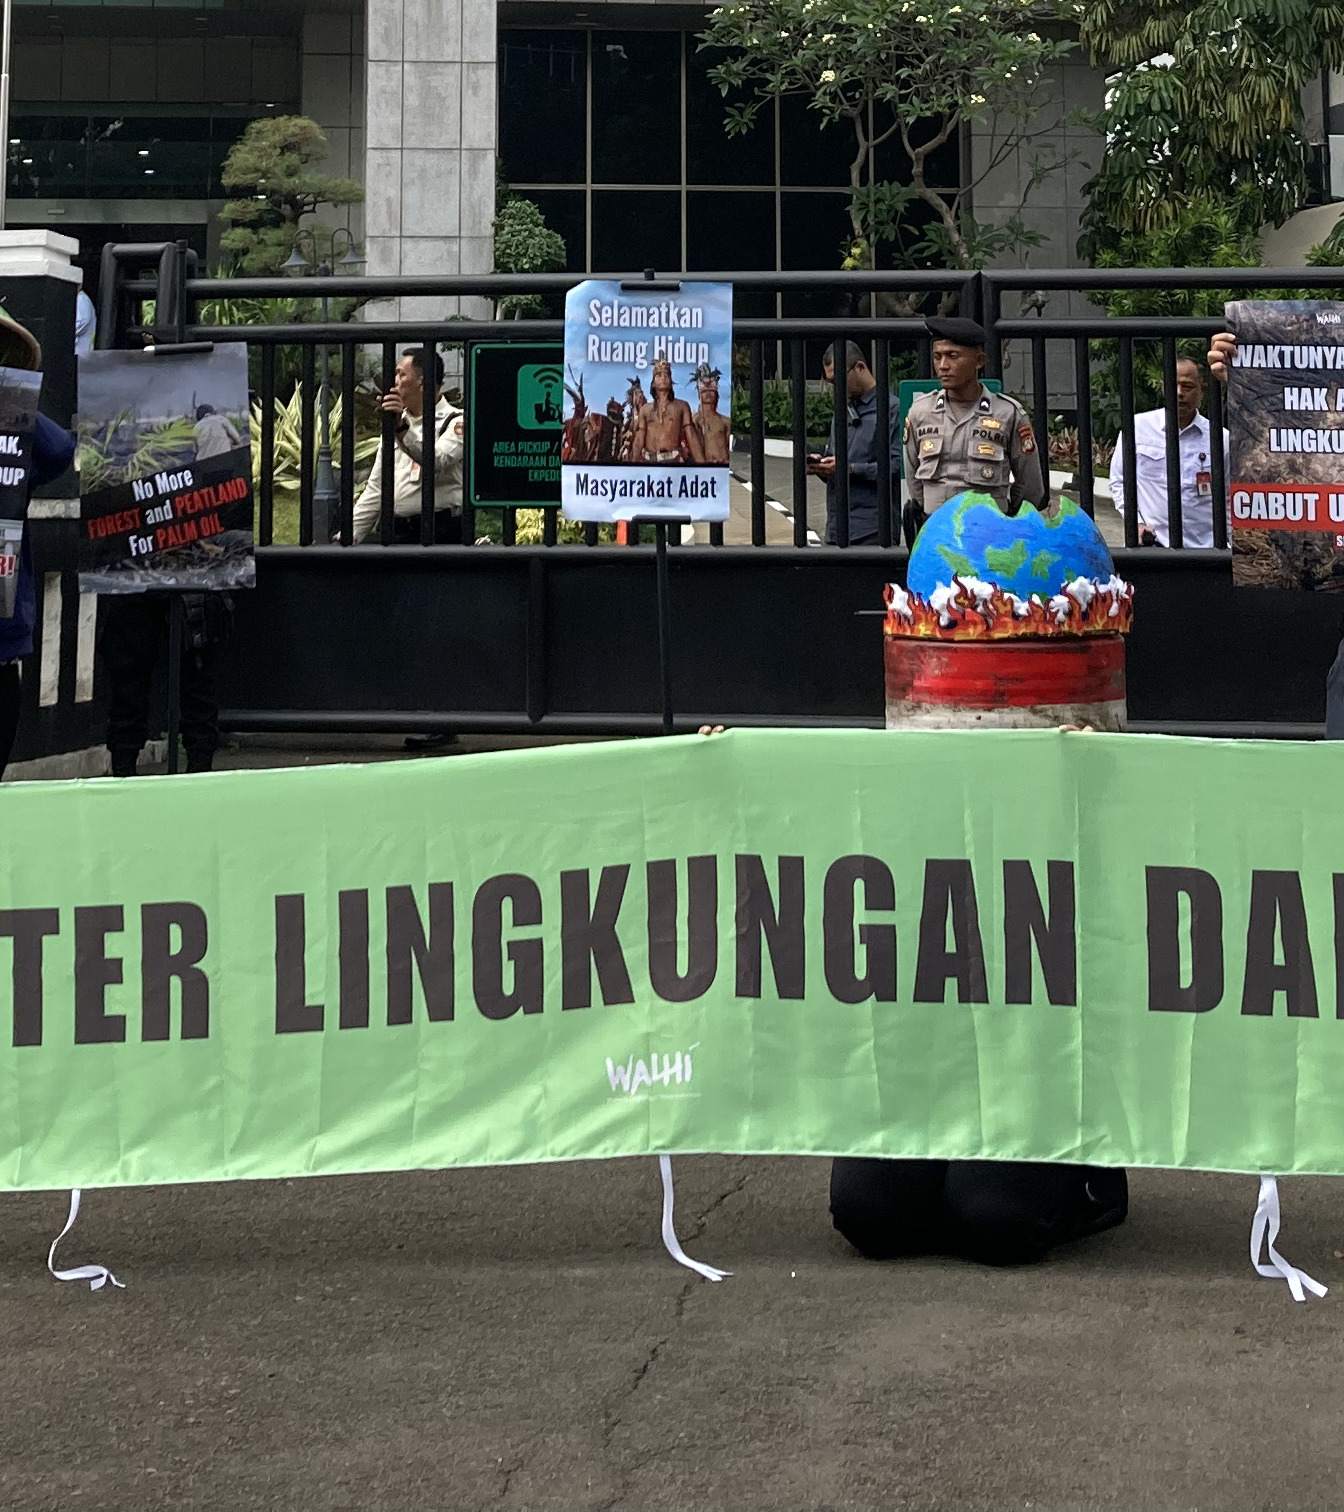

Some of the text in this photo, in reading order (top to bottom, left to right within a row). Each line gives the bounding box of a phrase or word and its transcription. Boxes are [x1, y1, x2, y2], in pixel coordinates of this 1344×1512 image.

[588, 299, 703, 328] Selamatkan
[587, 334, 709, 370] Ruang Hidup
[1284, 386, 1329, 412] HAK
[493, 441, 516, 454] AREA
[518, 441, 551, 454] PICKUP
[493, 455, 562, 467] KENDARAAN DA
[131, 469, 194, 502] No More
[575, 472, 717, 503] Masyarakat Adat
[87, 477, 249, 540] FOREST and PEATLAND
[1232, 490, 1320, 522] CABUT
[128, 513, 225, 557] For PALM OIL
[274, 854, 1077, 1035] LINGKUNGAN
[605, 1043, 701, 1096] WALHI
